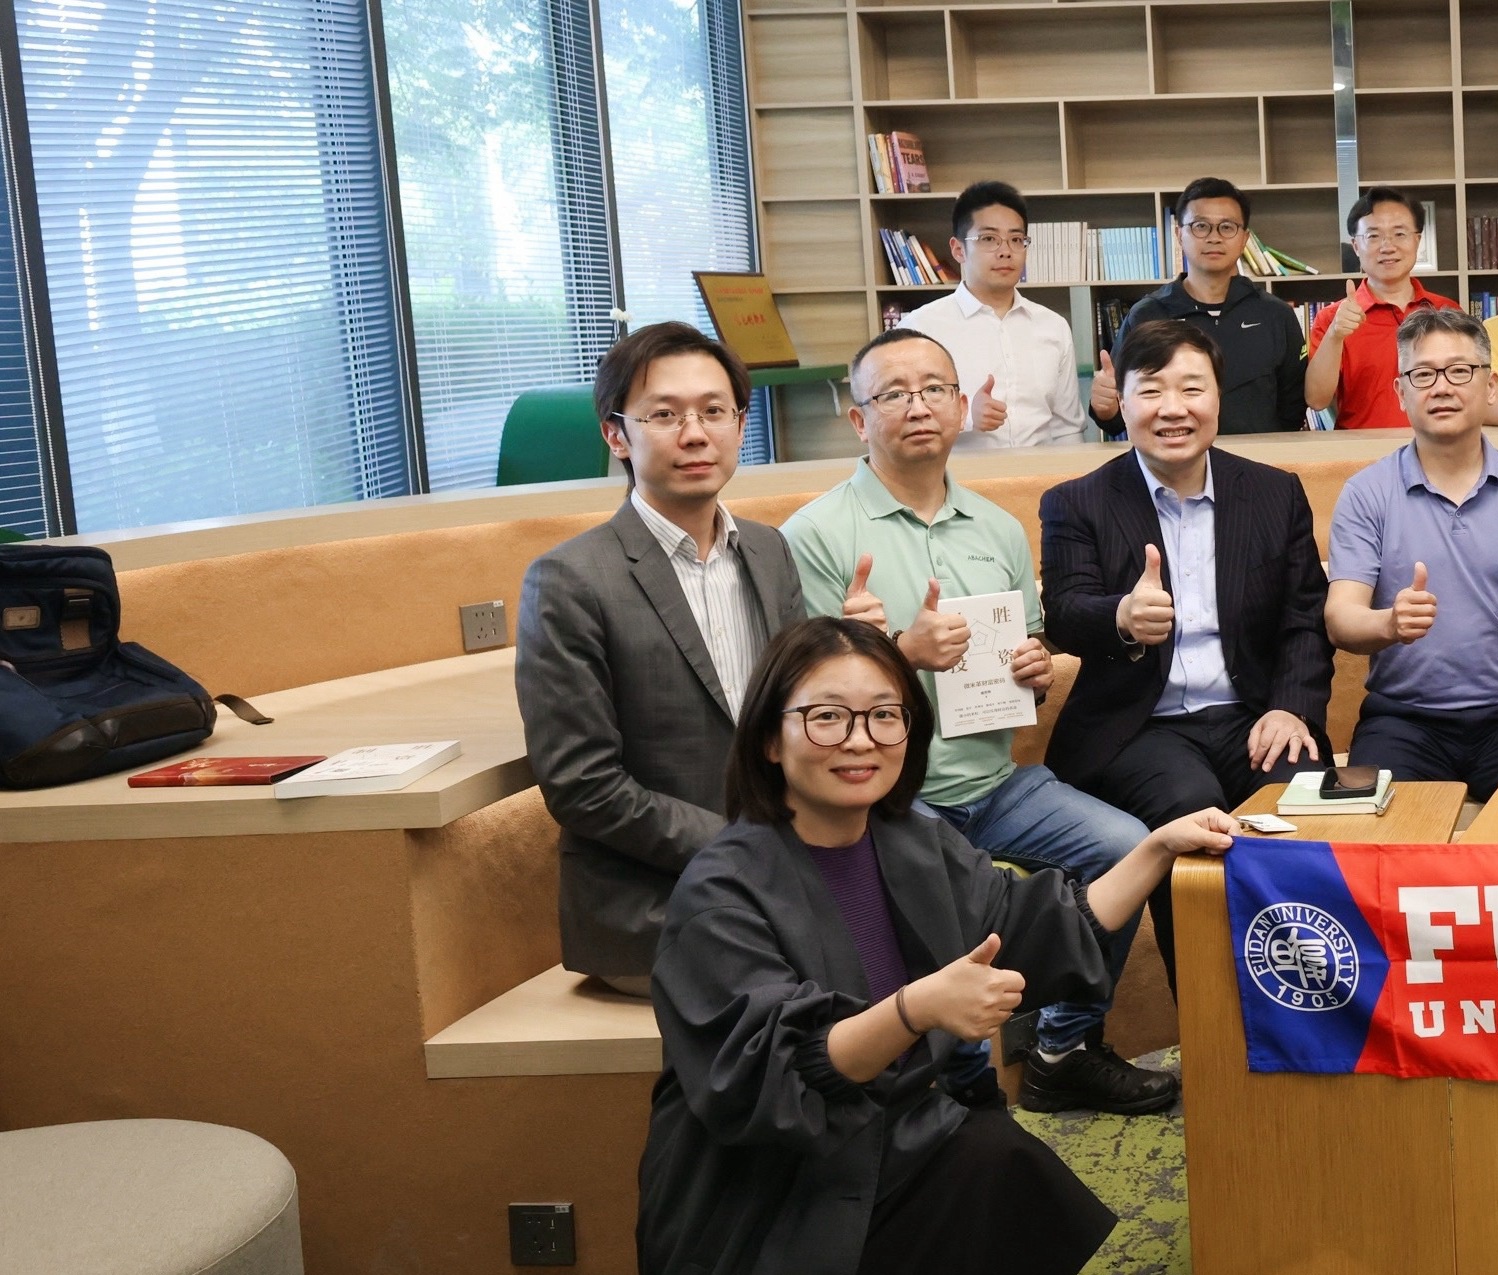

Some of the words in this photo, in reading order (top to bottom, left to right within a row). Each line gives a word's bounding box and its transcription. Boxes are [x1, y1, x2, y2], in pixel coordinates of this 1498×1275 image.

[992, 606, 1012, 624] 胜
[1249, 915, 1272, 977] FUDAN
[1268, 906, 1354, 988] UNIVERSITY
[1277, 985, 1338, 1008] 1905
